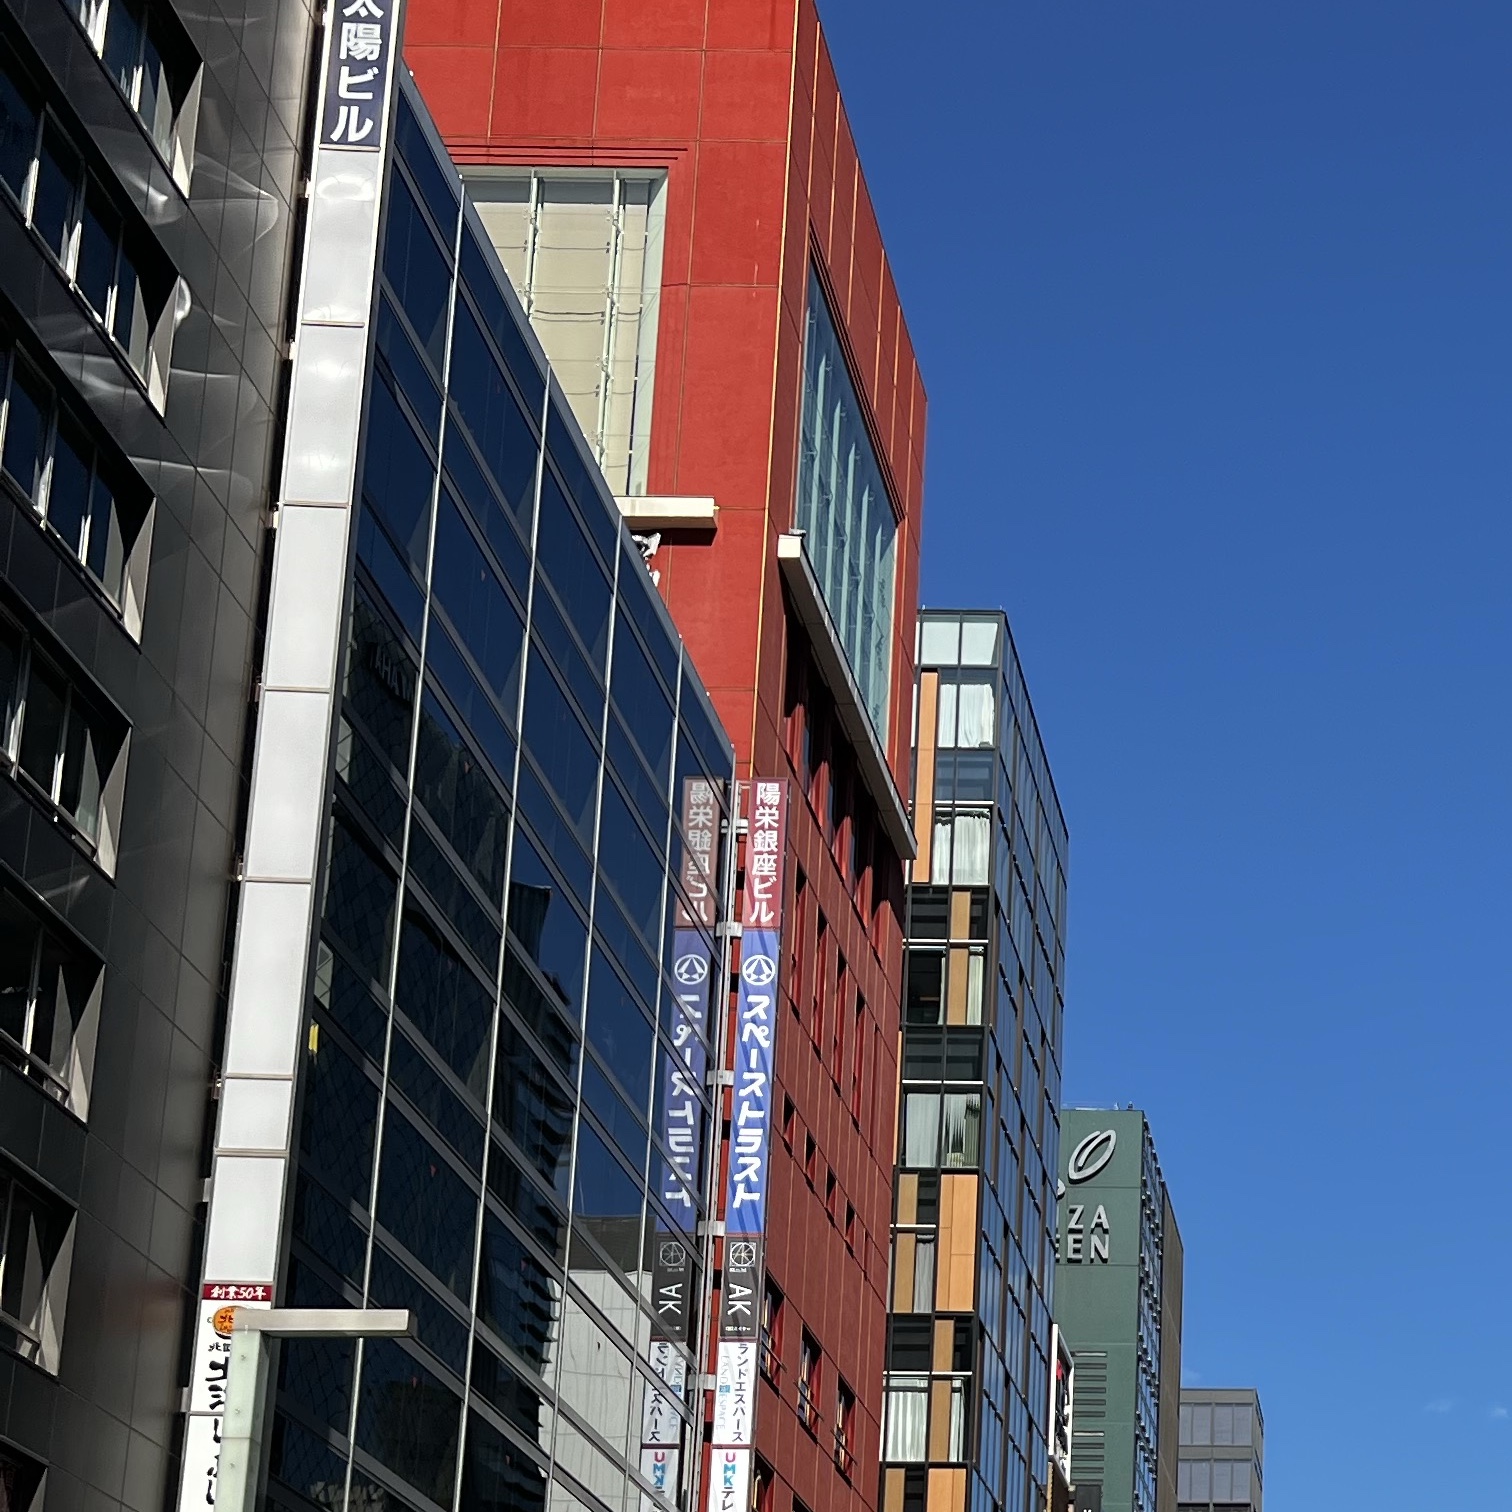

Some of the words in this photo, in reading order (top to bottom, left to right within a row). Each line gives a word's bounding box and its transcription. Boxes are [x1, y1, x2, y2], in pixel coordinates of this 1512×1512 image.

[749, 782, 781, 924] 陽栄銀座ビル
[732, 994, 771, 1209] スペーストラスト
[727, 1282, 753, 1316] AK
